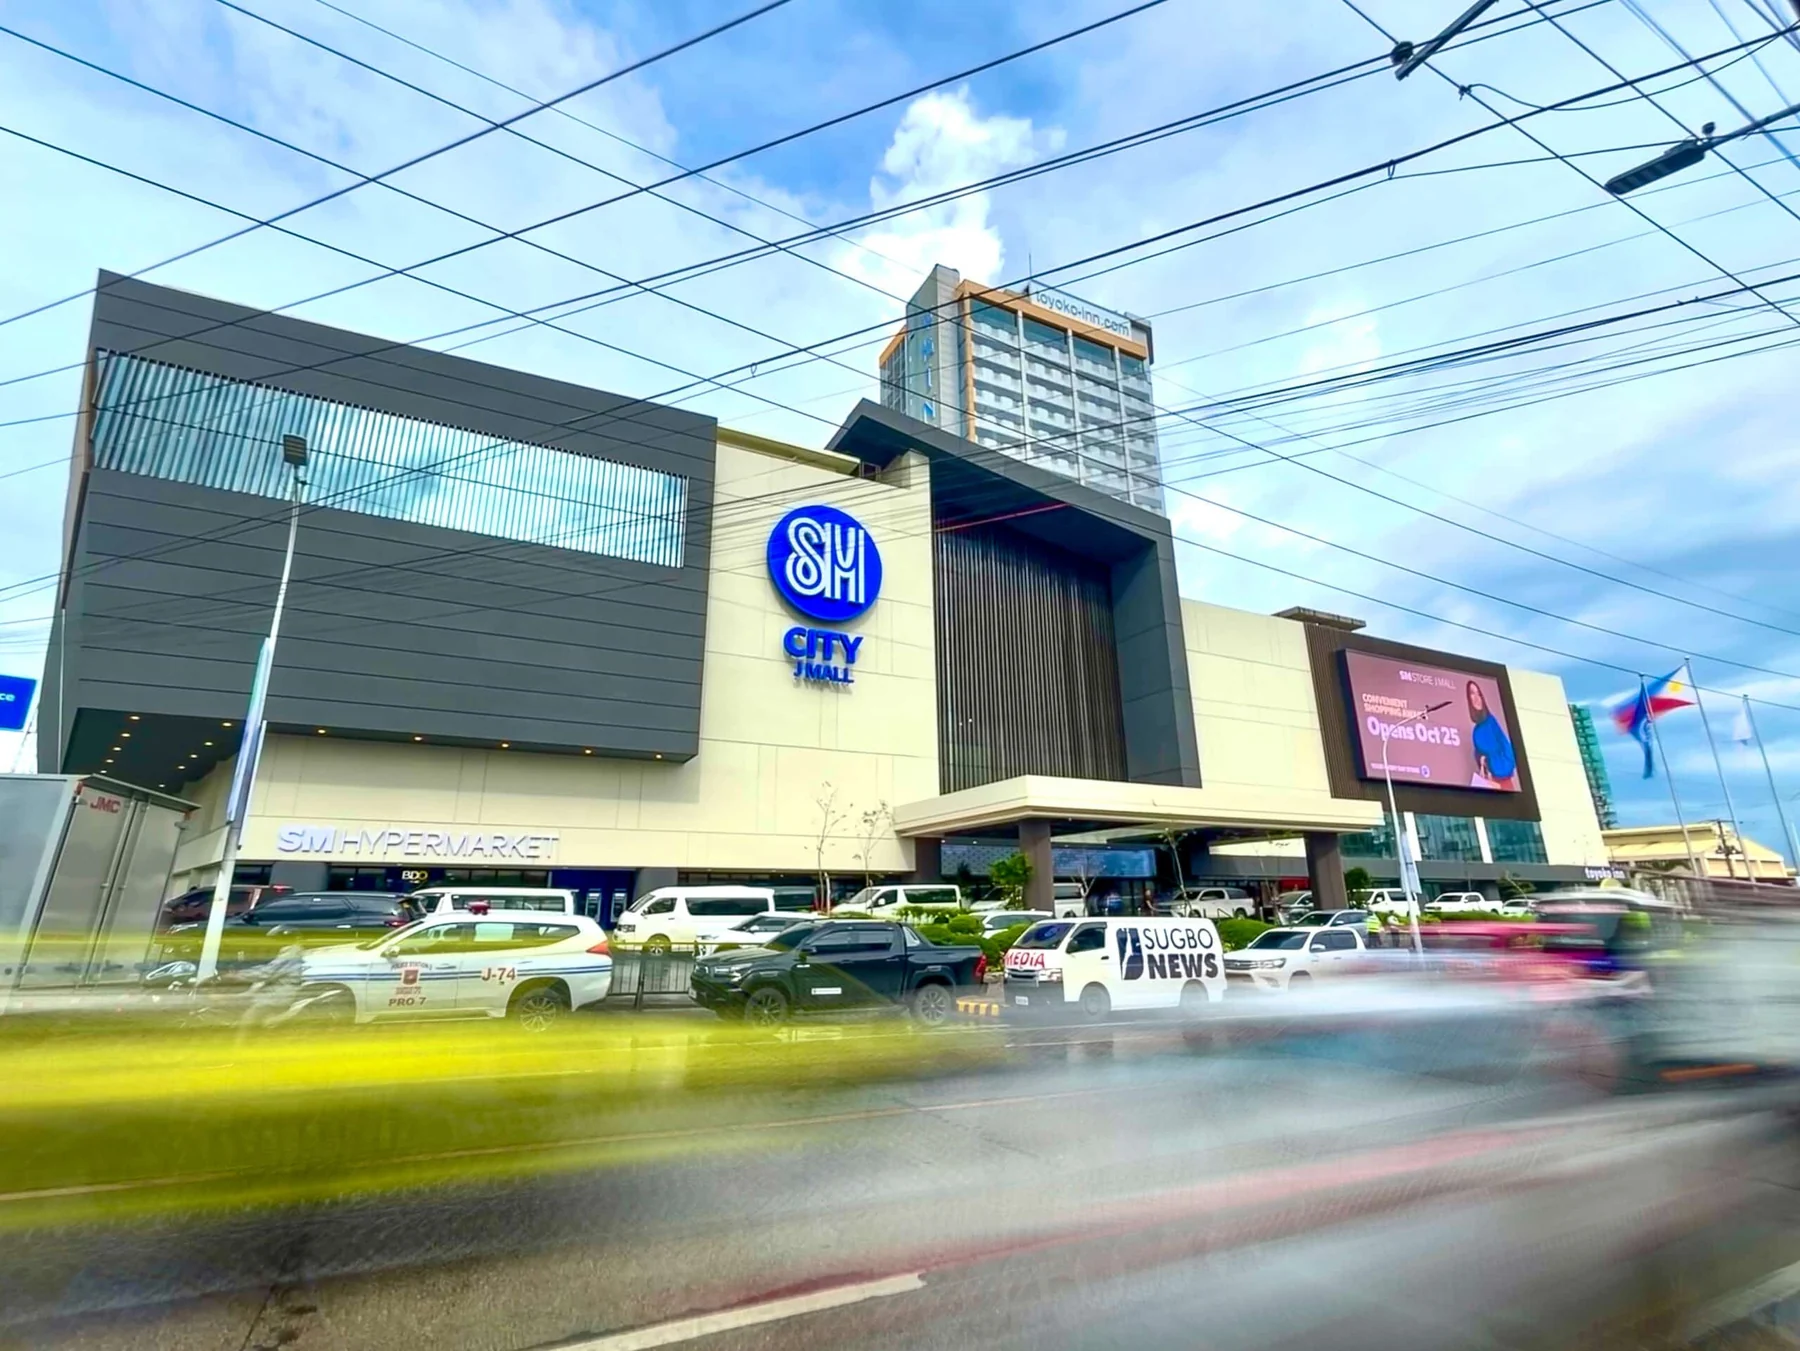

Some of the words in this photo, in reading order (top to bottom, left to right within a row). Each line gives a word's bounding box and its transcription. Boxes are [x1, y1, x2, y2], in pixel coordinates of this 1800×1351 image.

[785, 517, 866, 604] SM
[783, 626, 864, 664] CITY
[805, 662, 854, 683] MALL
[1367, 716, 1414, 741] Opens
[1415, 722, 1440, 744] Oct
[1441, 727, 1460, 746] 25
[90, 796, 121, 814] JMC
[401, 870, 428, 880] BDO
[1144, 928, 1214, 949] SUGBO
[482, 967, 516, 981] J-74
[1148, 953, 1219, 979] NEWS
[388, 997, 415, 1007] PRO
[419, 996, 427, 1006] 7
